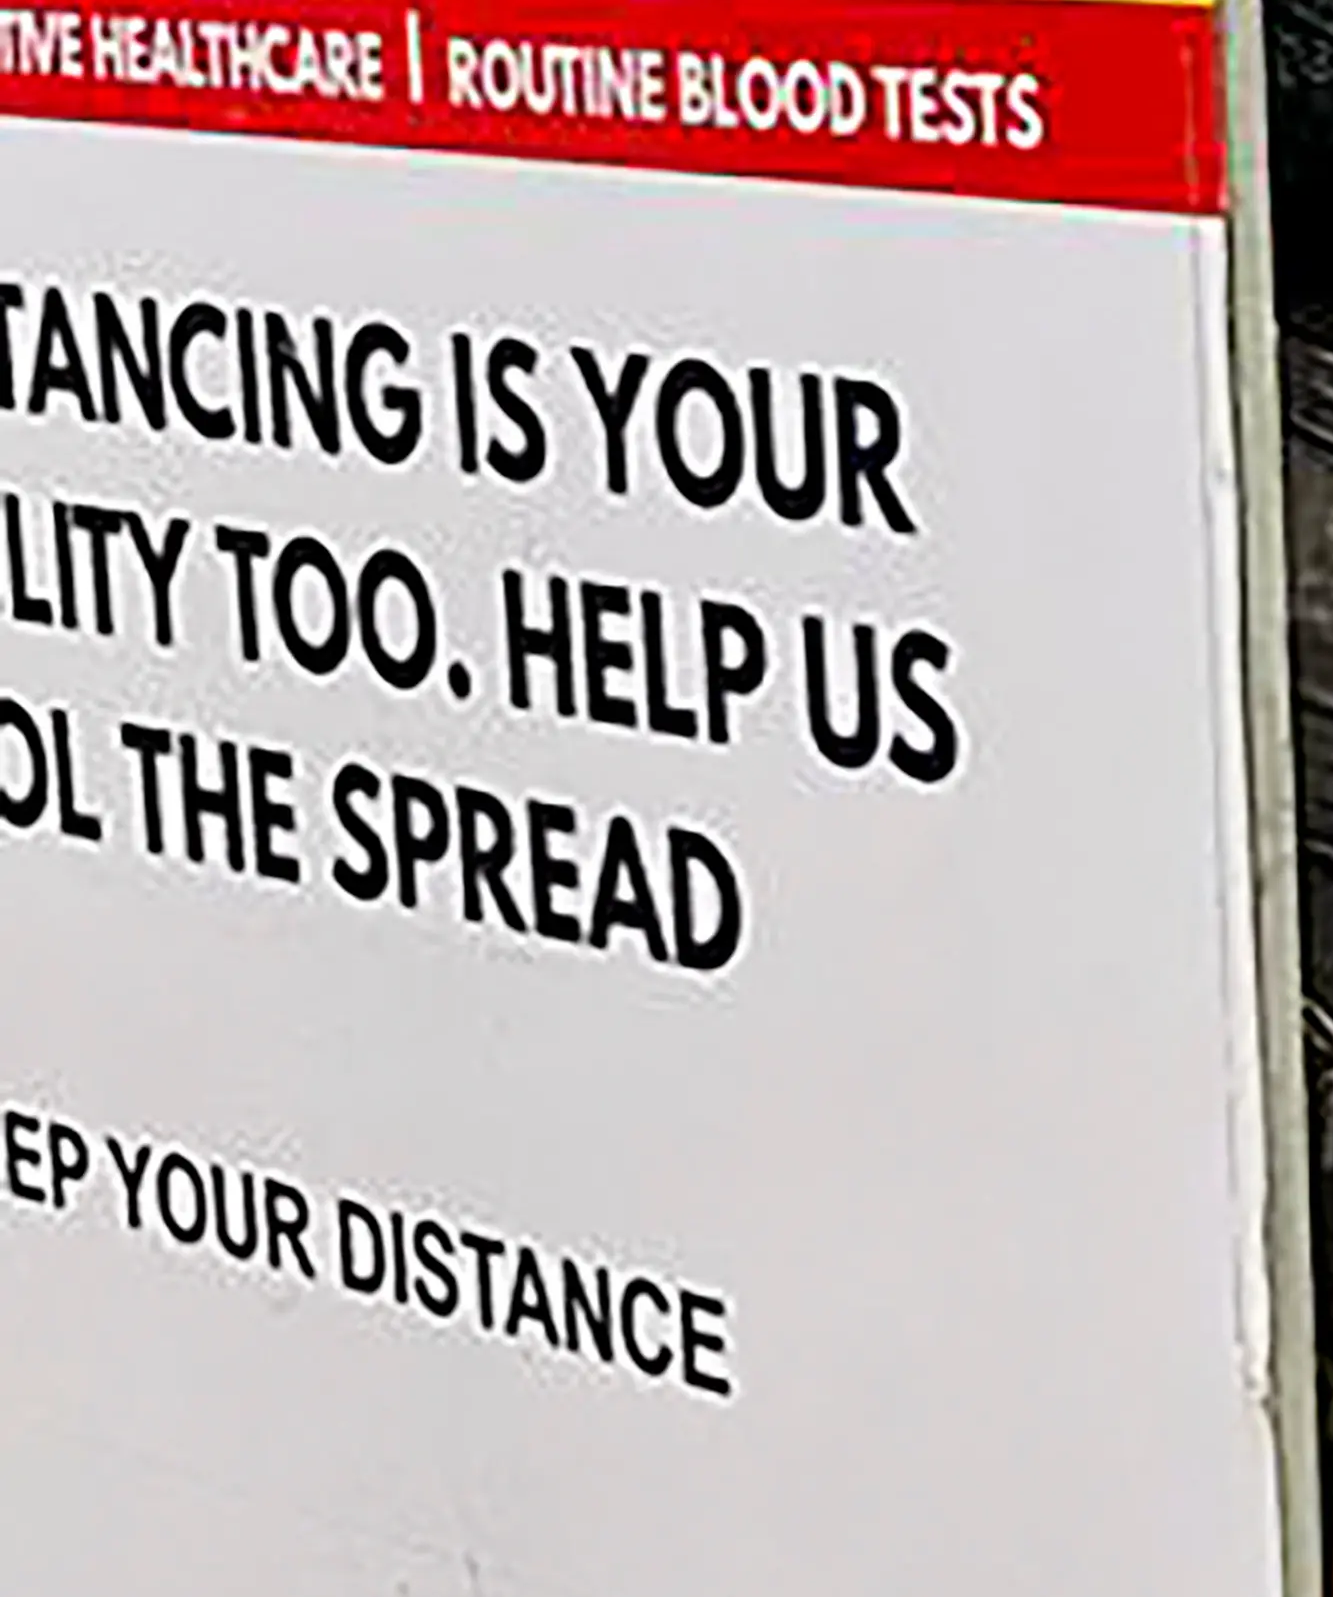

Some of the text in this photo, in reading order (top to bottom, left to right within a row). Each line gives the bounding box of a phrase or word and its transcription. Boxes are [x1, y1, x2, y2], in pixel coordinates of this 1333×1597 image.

[91, 16, 383, 99] HEALTHCARE
[449, 40, 1042, 148] ROUTINE BLOOD TESTS
[0, 284, 916, 534] TANCING IS YOUR
[5, 493, 956, 783] LITY TOO. HELP US
[0, 699, 740, 970] OL THE SPREAD
[5, 1111, 730, 1395] EP YOUR DISTANCE
